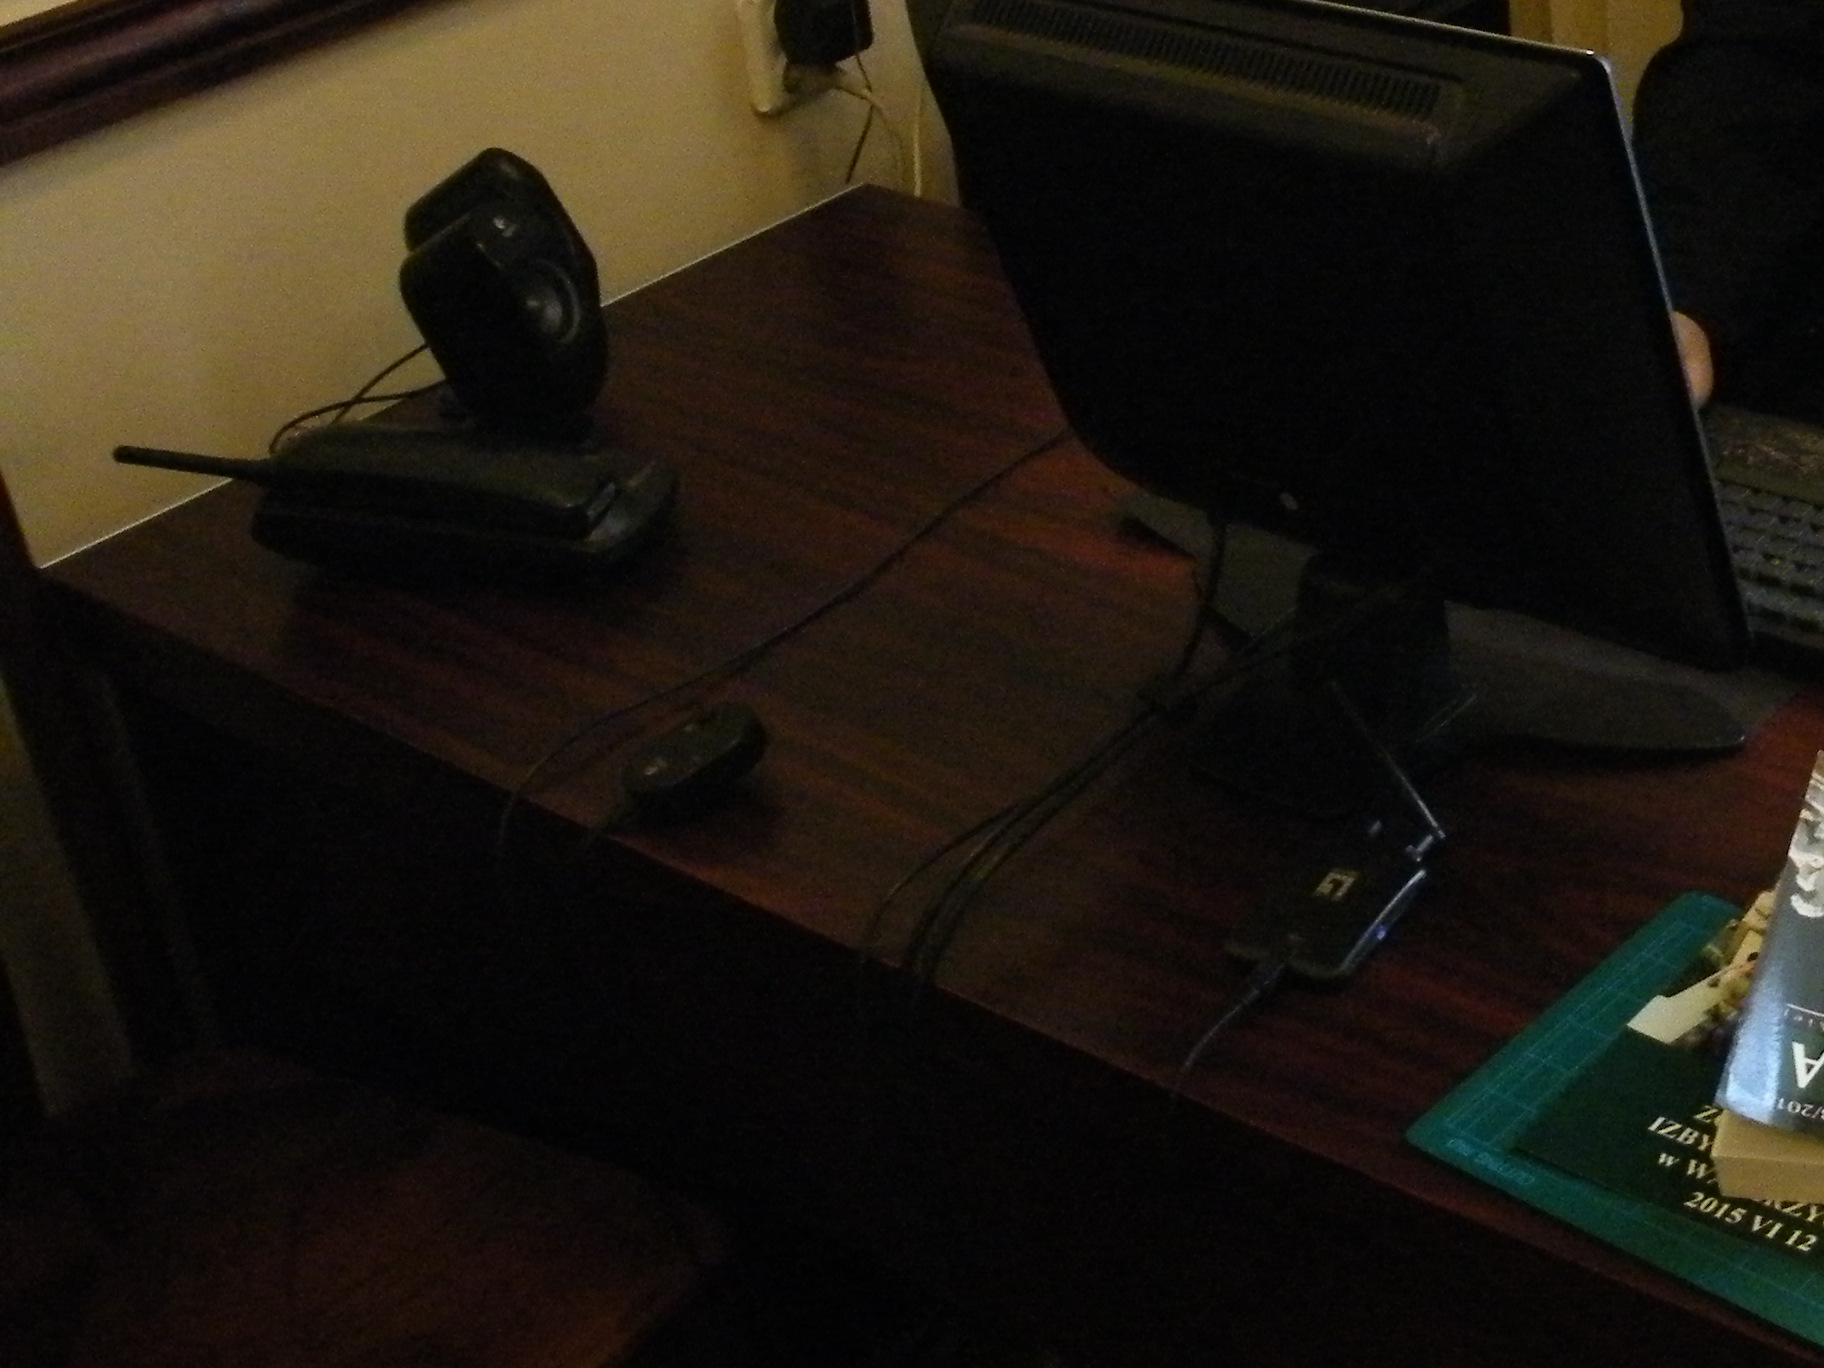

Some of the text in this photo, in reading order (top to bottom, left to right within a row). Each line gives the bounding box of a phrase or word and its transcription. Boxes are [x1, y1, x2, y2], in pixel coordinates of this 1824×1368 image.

[1647, 1115, 1713, 1152] IZBY
[1656, 1152, 1681, 1168] w
[1683, 1191, 1820, 1253] 2015 VI 12
